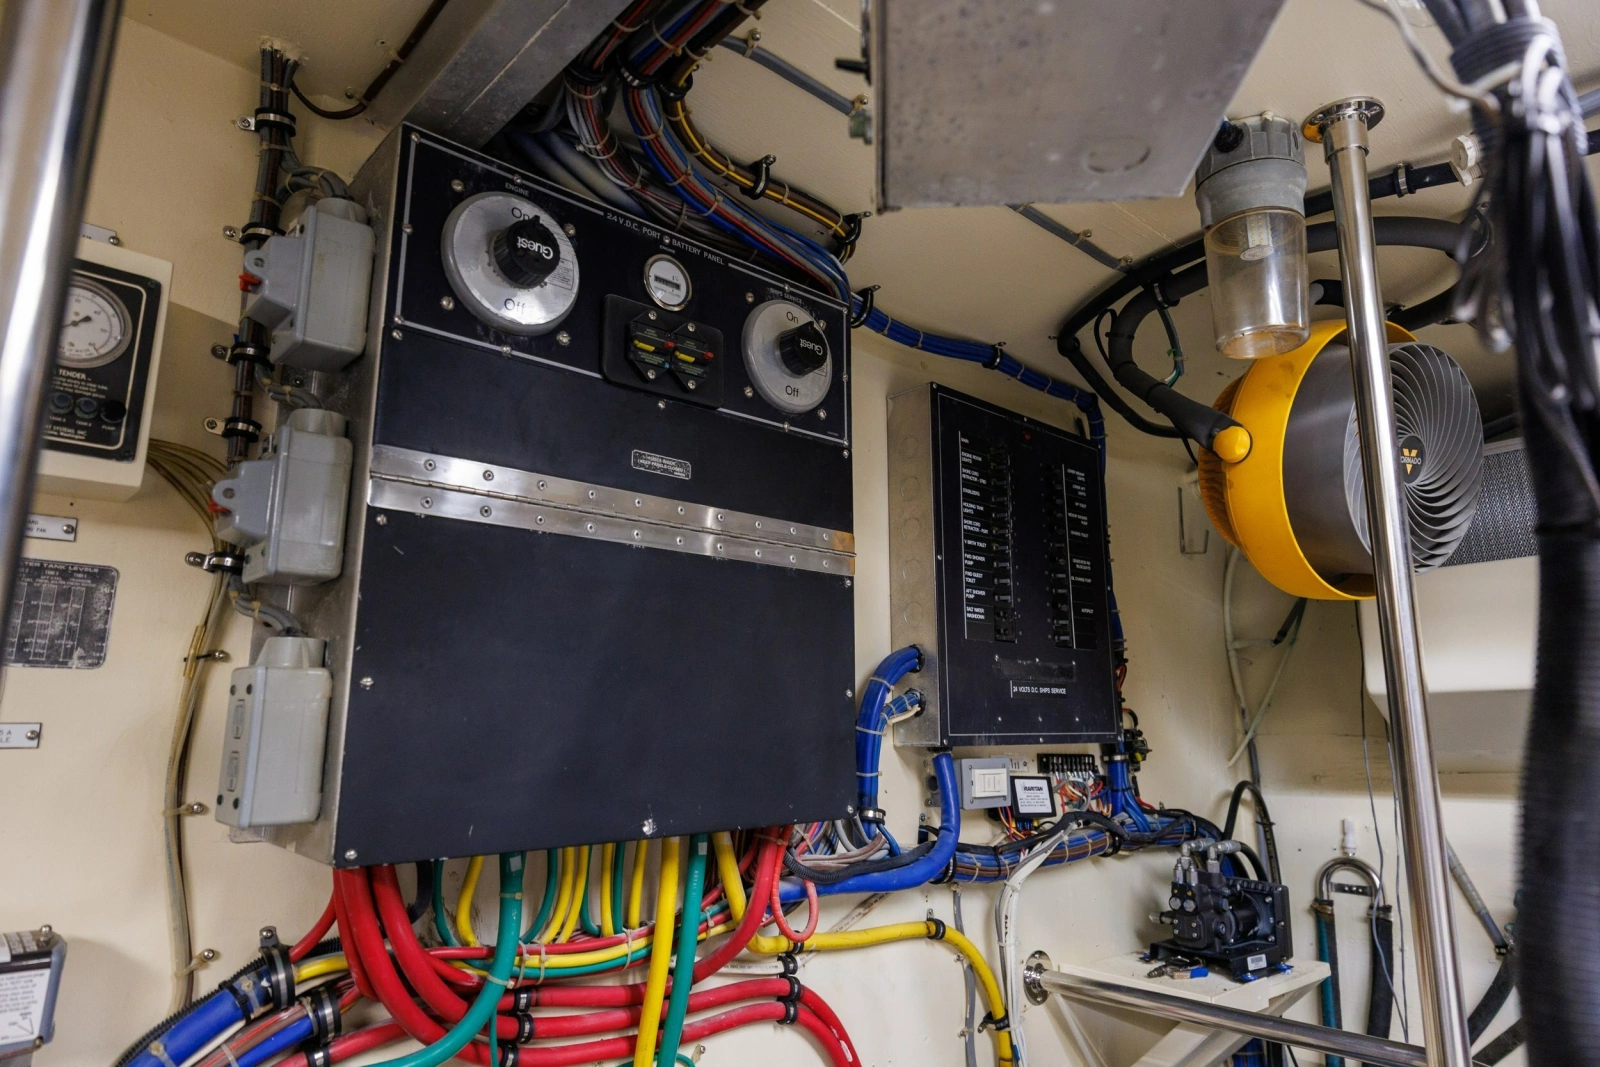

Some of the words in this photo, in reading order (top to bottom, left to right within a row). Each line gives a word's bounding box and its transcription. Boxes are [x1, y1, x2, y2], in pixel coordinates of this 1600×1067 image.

[505, 182, 530, 196] ENGINE
[511, 207, 530, 220] On
[607, 213, 617, 222] 24
[642, 227, 661, 239] PORT
[672, 239, 701, 256] BATTERY
[703, 251, 725, 265] PANEL
[517, 236, 554, 259] Guest
[660, 245, 676, 254] ENGINE
[504, 298, 526, 314] Off
[786, 312, 799, 323] On
[800, 338, 823, 356] Guest
[58, 369, 86, 381] TENDER
[785, 385, 799, 397] Off
[59, 431, 85, 440] Washington
